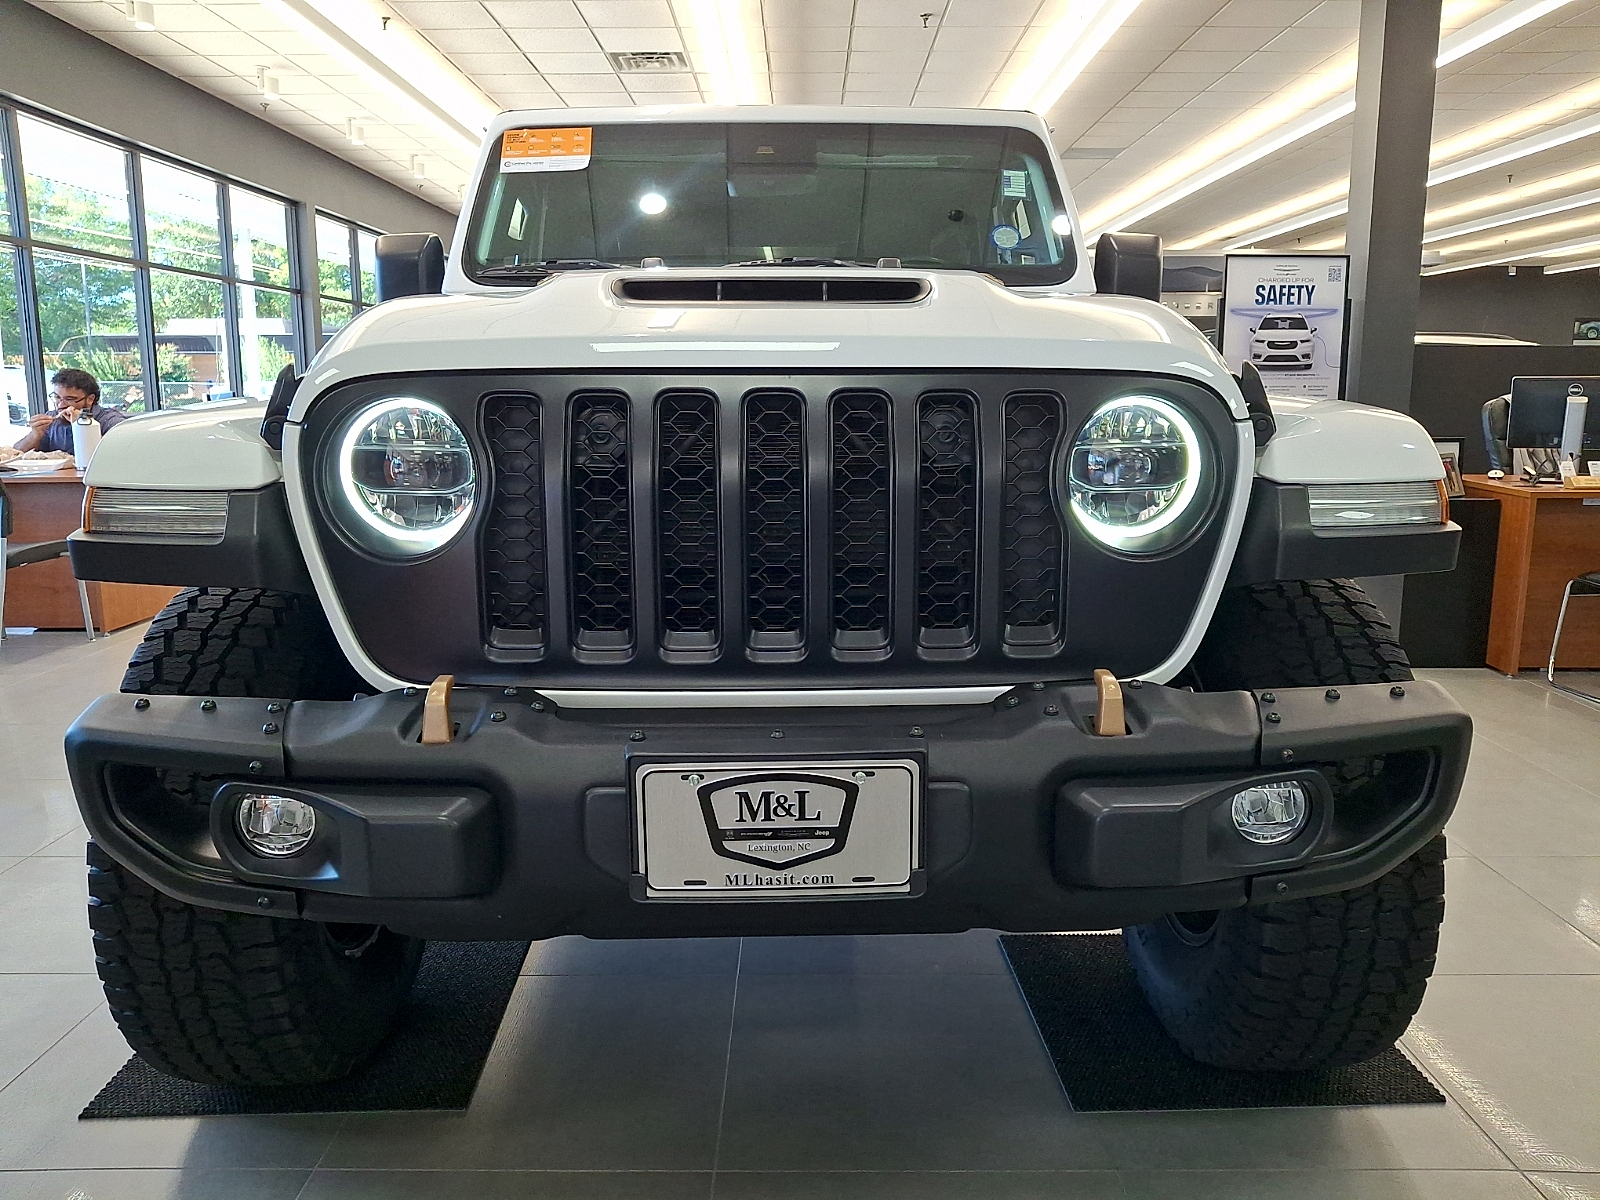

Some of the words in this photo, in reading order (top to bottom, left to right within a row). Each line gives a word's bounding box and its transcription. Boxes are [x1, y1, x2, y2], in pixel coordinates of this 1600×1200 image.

[1254, 284, 1316, 306] SAFETY
[734, 789, 822, 823] M&L
[814, 829, 830, 837] Jeep
[748, 842, 796, 853] Lexington,
[797, 842, 811, 851] NC
[724, 872, 835, 887] MLhasit.com
